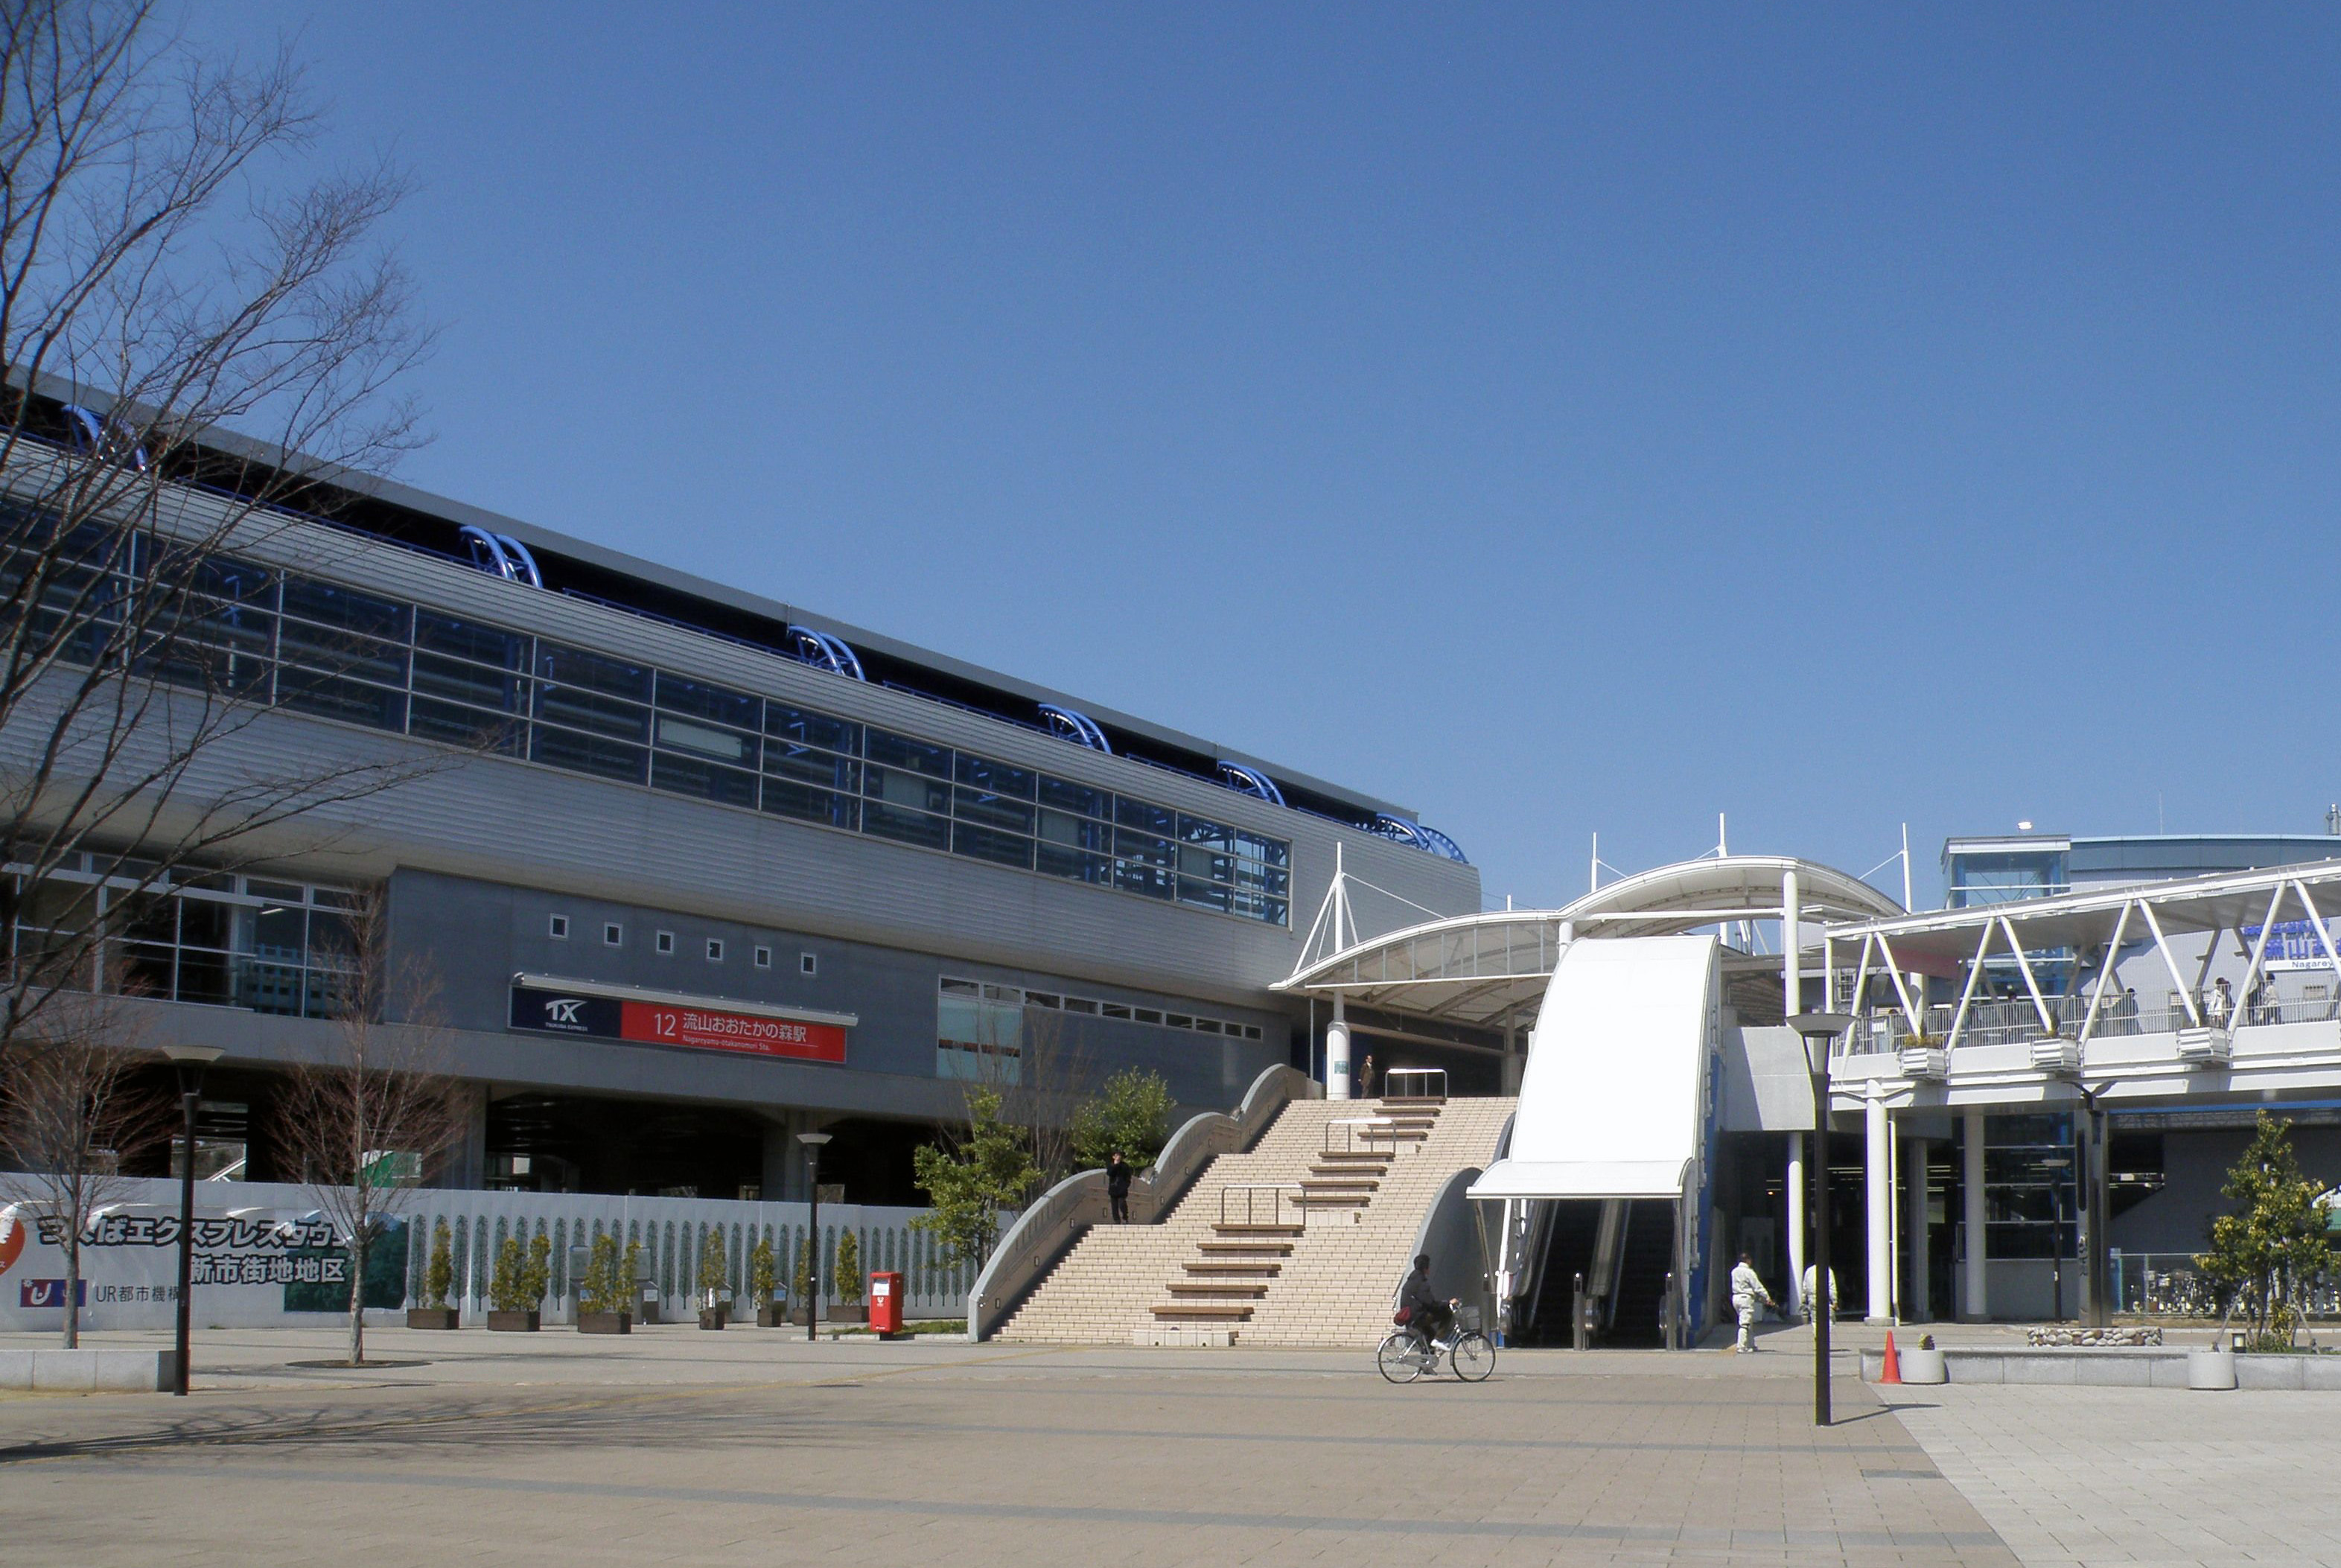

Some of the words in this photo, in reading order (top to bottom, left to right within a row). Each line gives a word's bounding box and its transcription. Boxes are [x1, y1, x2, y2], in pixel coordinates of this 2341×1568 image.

[546, 999, 587, 1022] TX
[654, 1013, 676, 1036] 12
[683, 1013, 806, 1042] 流山おおたかの森駅
[191, 1254, 347, 1284] 新市街地地区
